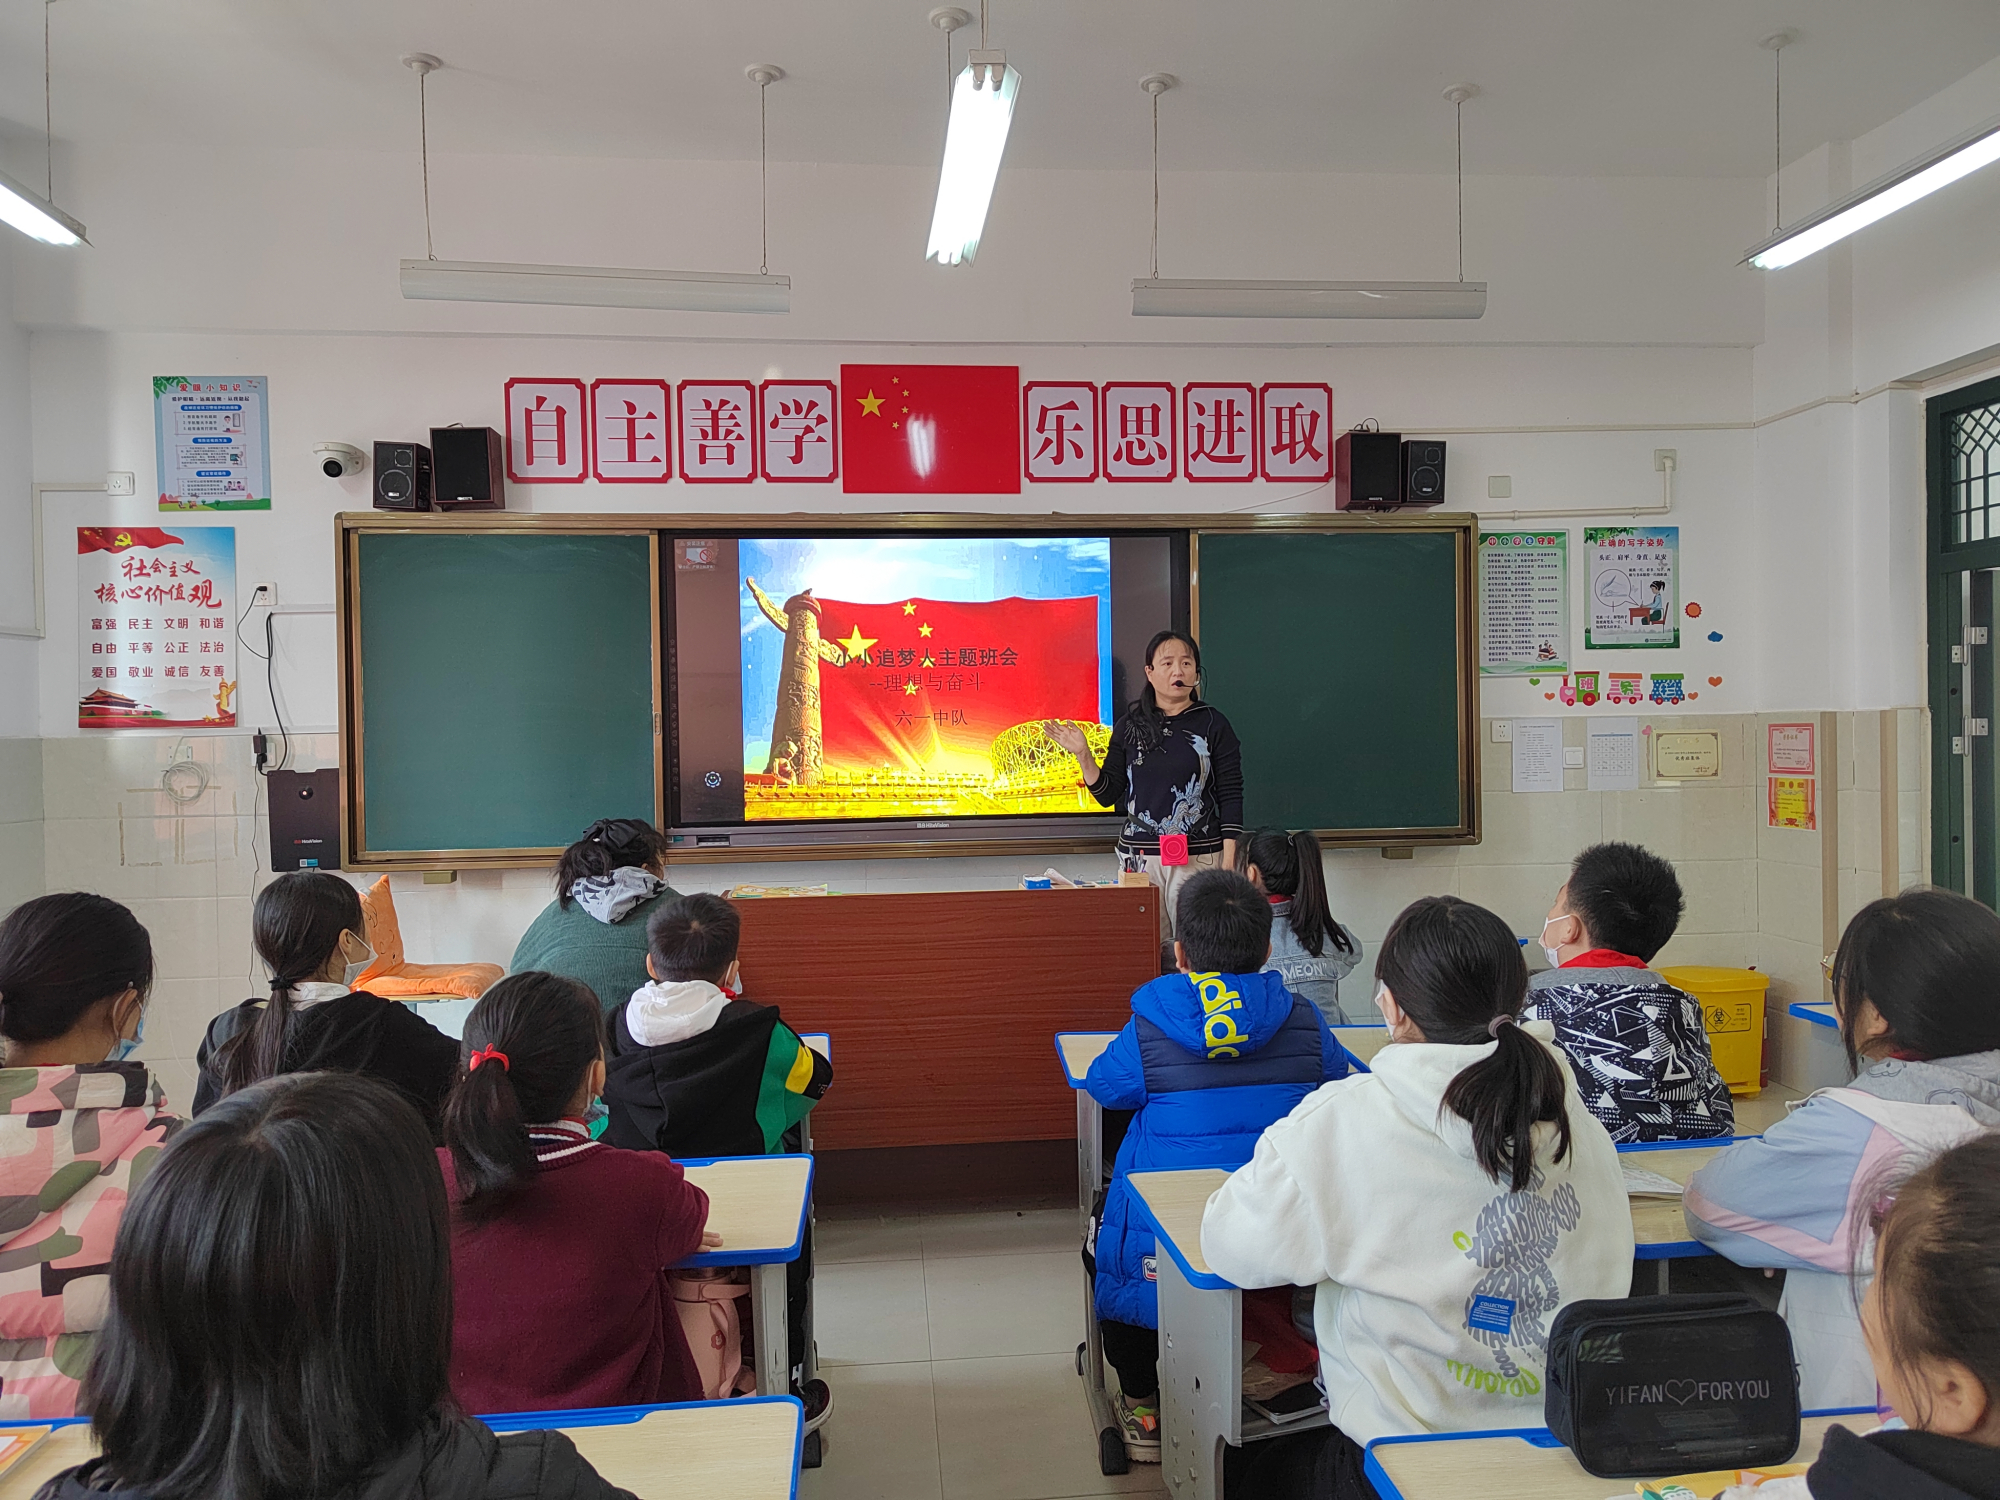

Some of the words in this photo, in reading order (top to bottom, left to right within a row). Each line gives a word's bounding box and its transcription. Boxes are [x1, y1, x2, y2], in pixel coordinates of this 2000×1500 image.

[179, 384, 242, 392] 爱眼小知识
[523, 395, 829, 466] 自主善学
[1031, 399, 1324, 466] 乐思进取
[1488, 535, 1556, 546] 中小学生守则
[1598, 538, 1665, 547] 正确的写字姿势
[121, 556, 201, 582] 社会主义
[94, 579, 222, 609] 核心价值观
[91, 618, 117, 630] 富强
[128, 618, 153, 630] 民主
[164, 618, 189, 630] 文明
[199, 617, 224, 629] 和谐
[92, 643, 117, 654] 自由
[128, 642, 153, 654] 平等
[164, 642, 189, 653] 公正
[199, 641, 224, 653] 法治
[836, 646, 1019, 668] 小小追梦人主题班会
[91, 666, 117, 678] 爱国
[128, 666, 153, 678] 敬业
[164, 666, 189, 677] 诚信
[200, 665, 224, 677] 友善
[895, 709, 968, 727] 六一中队
[1480, 1301, 1510, 1311] COLLECTION
[1606, 1384, 1663, 1405] YIFAN
